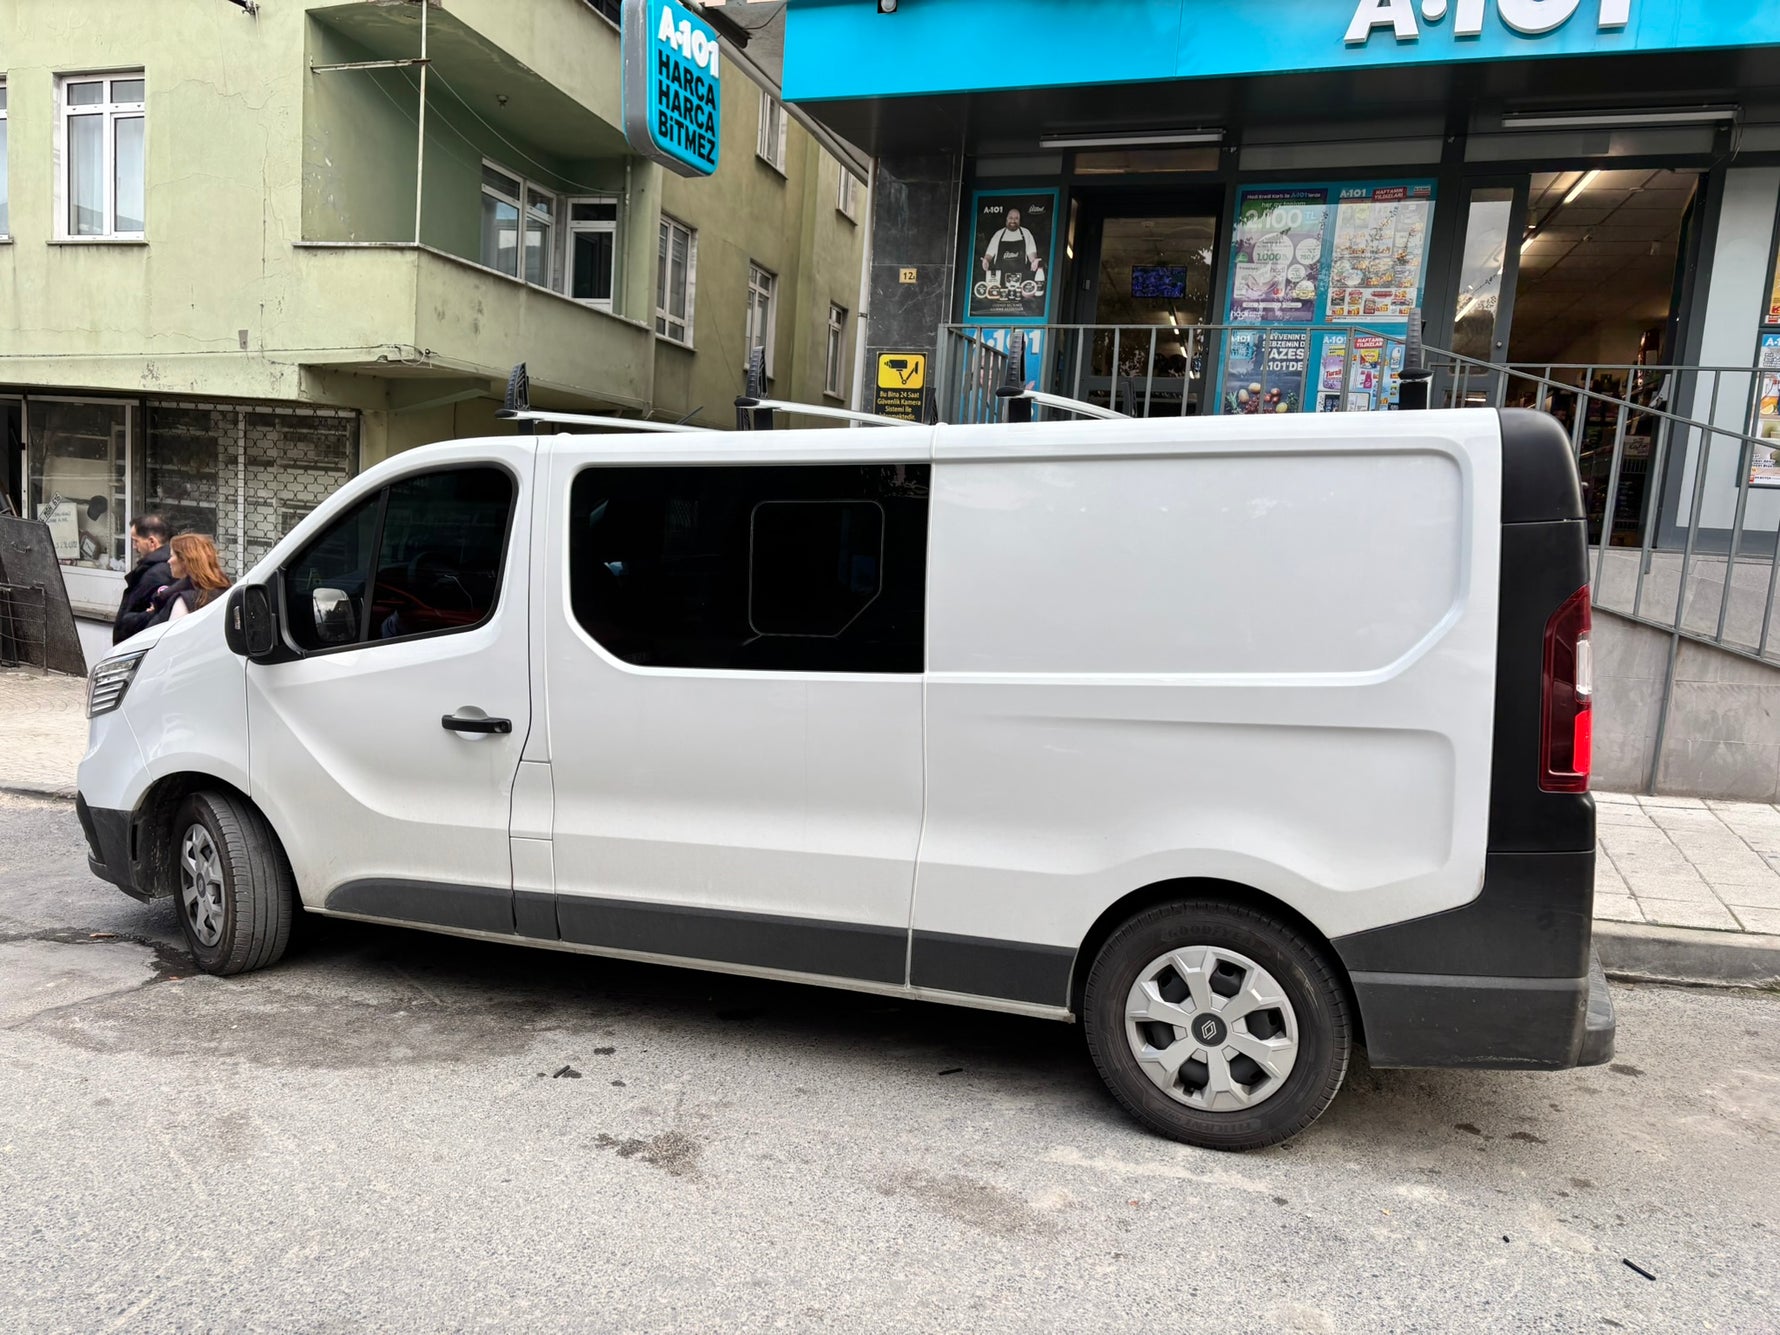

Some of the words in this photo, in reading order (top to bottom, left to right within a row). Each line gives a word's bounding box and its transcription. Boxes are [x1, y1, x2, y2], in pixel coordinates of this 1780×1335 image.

[658, 48, 716, 111] HARCA
[658, 78, 716, 138] HARCA
[658, 108, 715, 165] BİTMEZ
